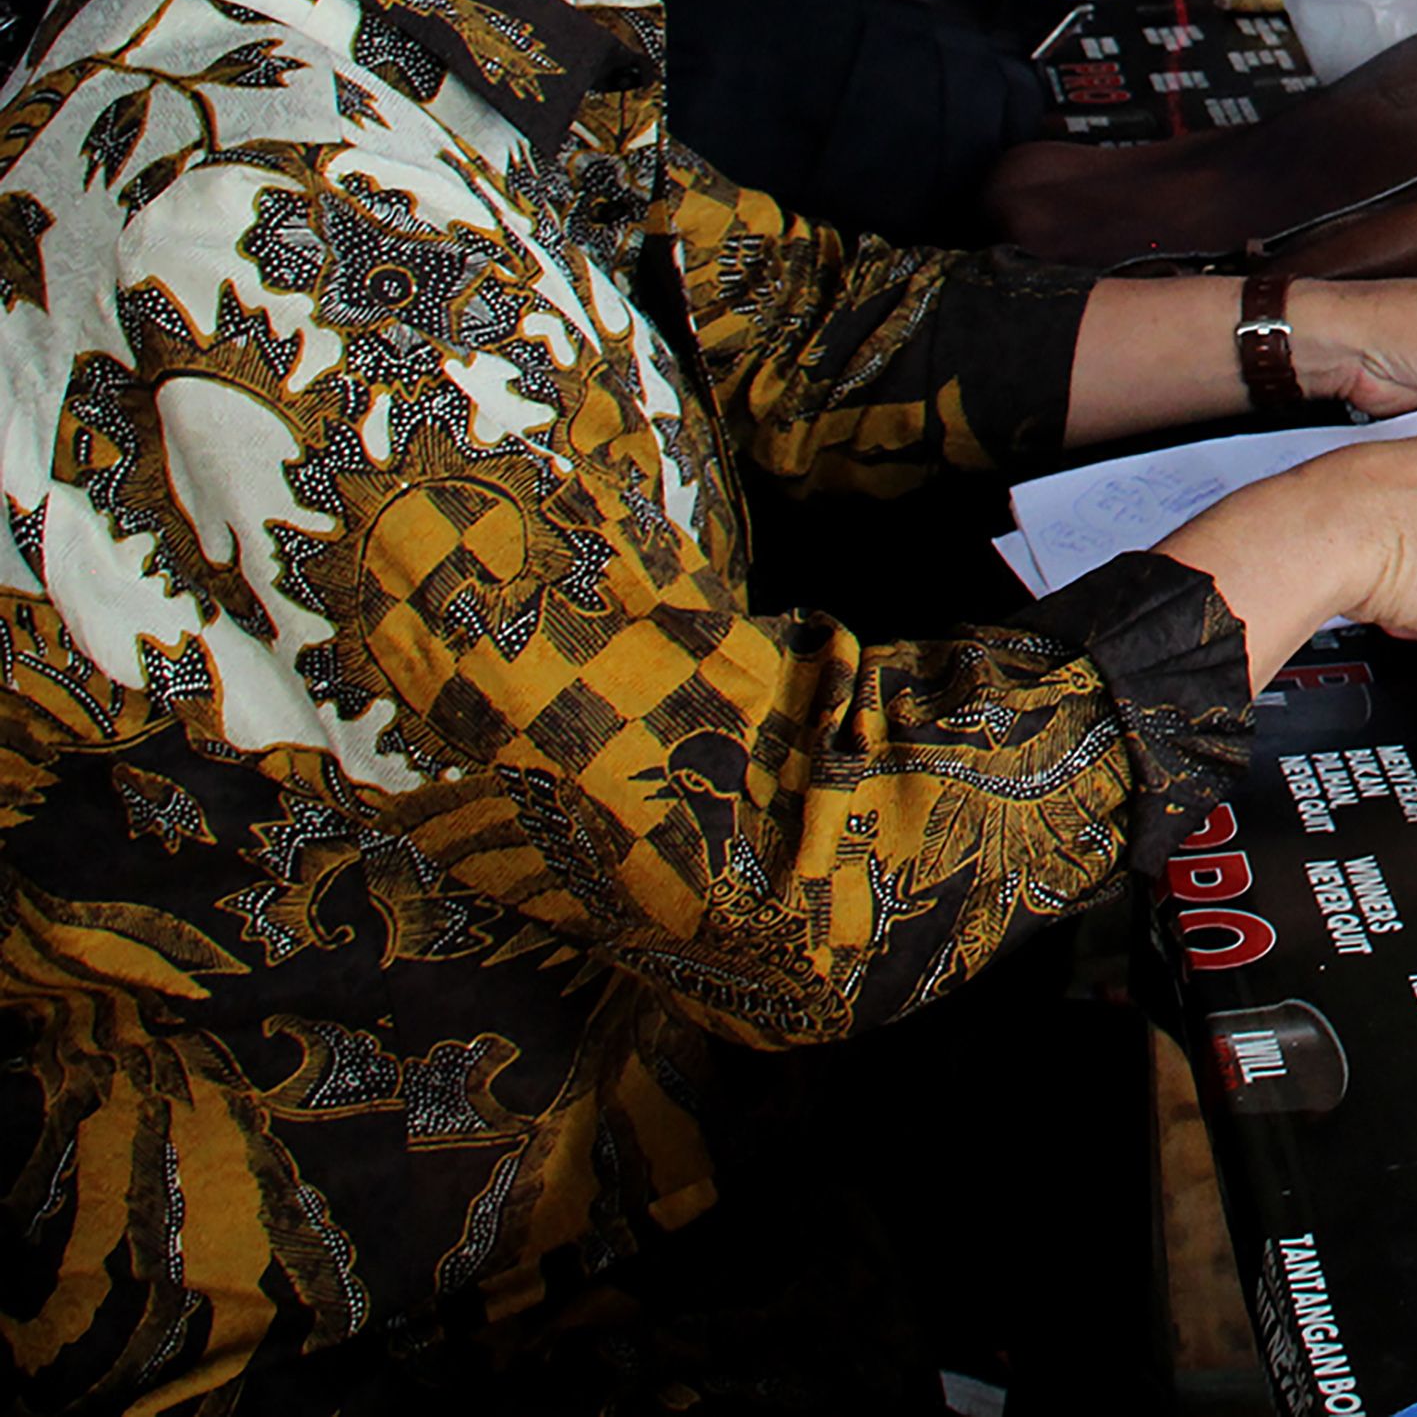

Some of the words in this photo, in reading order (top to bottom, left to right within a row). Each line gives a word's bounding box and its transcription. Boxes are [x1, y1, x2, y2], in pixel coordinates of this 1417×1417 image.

[1277, 754, 1322, 801] NEVER
[1343, 748, 1391, 799] BUKAN
[1296, 797, 1337, 833] QUIT
[1304, 859, 1354, 917] NEVER
[1343, 854, 1405, 934] WINNERS
[1326, 913, 1374, 955] QUIT
[1234, 1038, 1289, 1085] WILL
[1278, 1231, 1352, 1377] TANTANGAN
